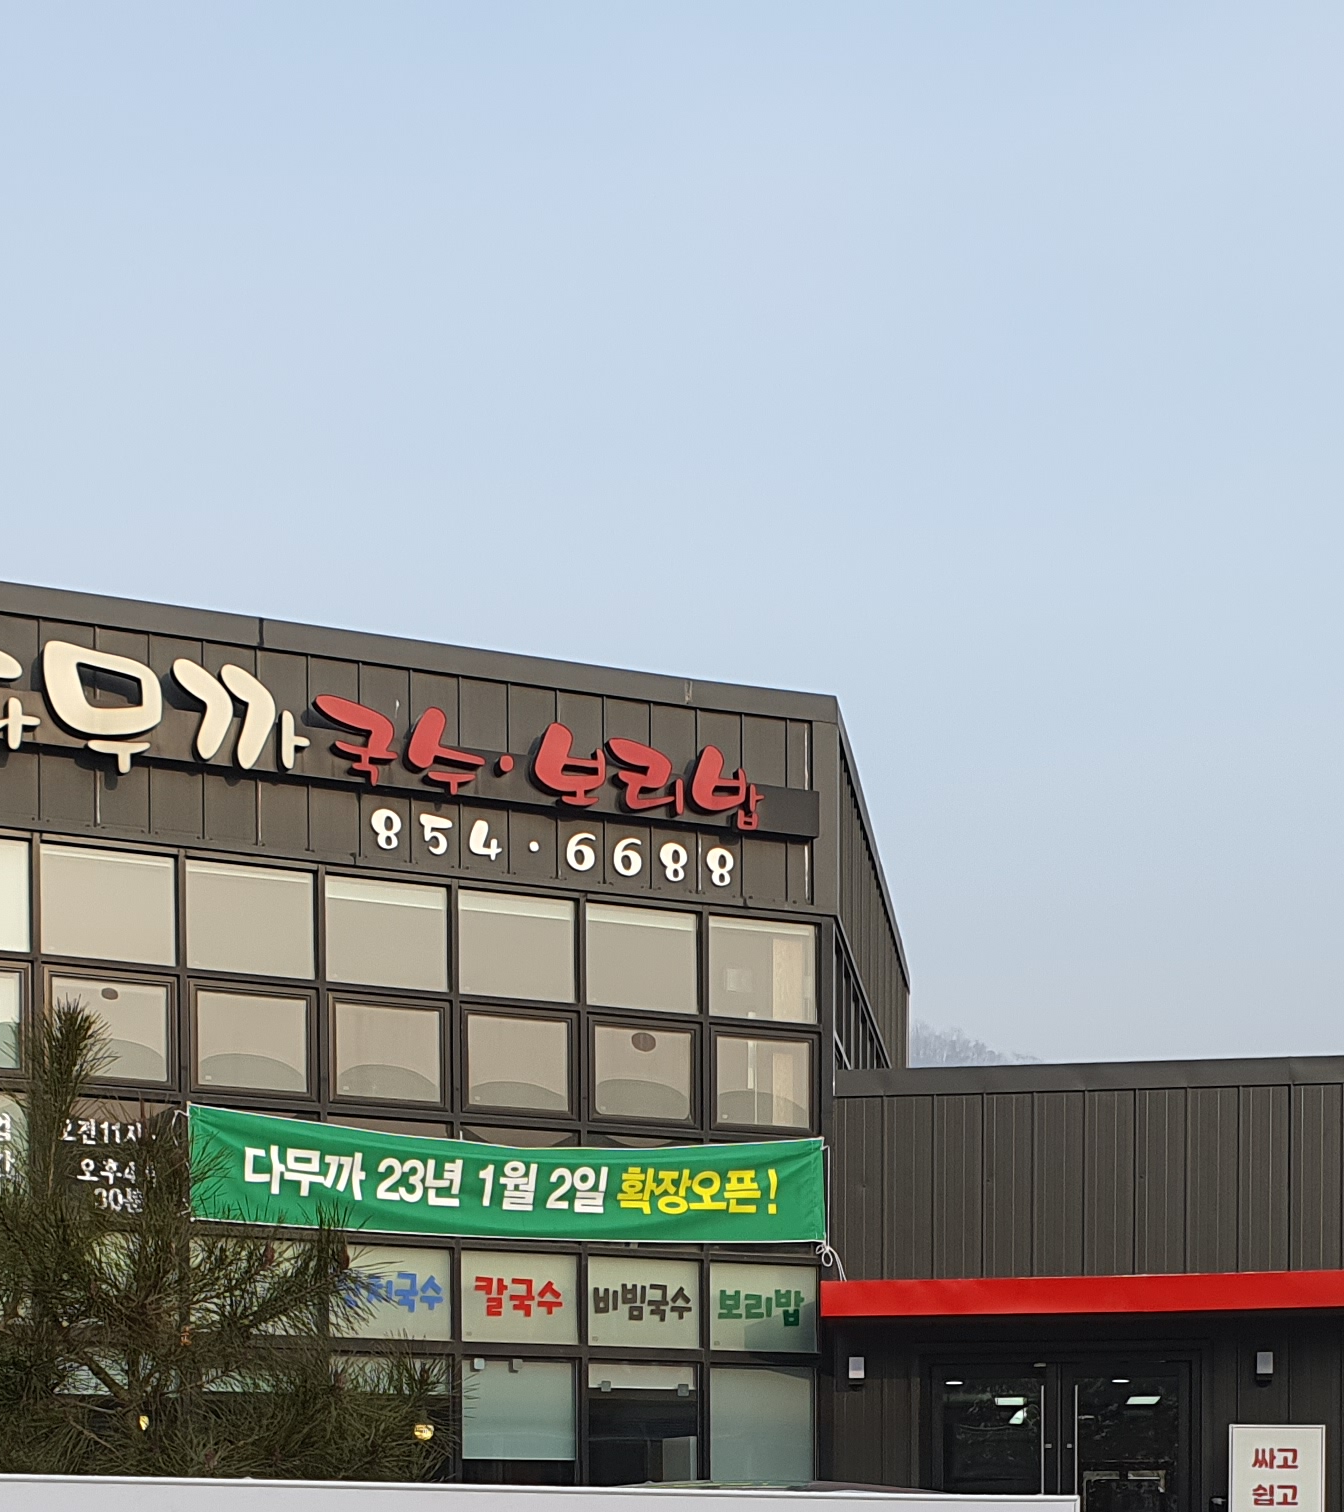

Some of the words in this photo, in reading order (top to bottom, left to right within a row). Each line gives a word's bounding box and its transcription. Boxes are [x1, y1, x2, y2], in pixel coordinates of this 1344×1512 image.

[243, 1143, 367, 1202] 다무까
[376, 1156, 462, 1208] 23년
[478, 1160, 539, 1212] 1월
[545, 1165, 609, 1215] 2일
[616, 1165, 780, 1217] 확장오픈!
[473, 1274, 564, 1318] 칼국수
[592, 1283, 693, 1323] 비빔국수
[716, 1288, 805, 1328] 보리밥
[1251, 1447, 1299, 1470] 싸고
[1251, 1484, 1299, 1507] 쉽고
